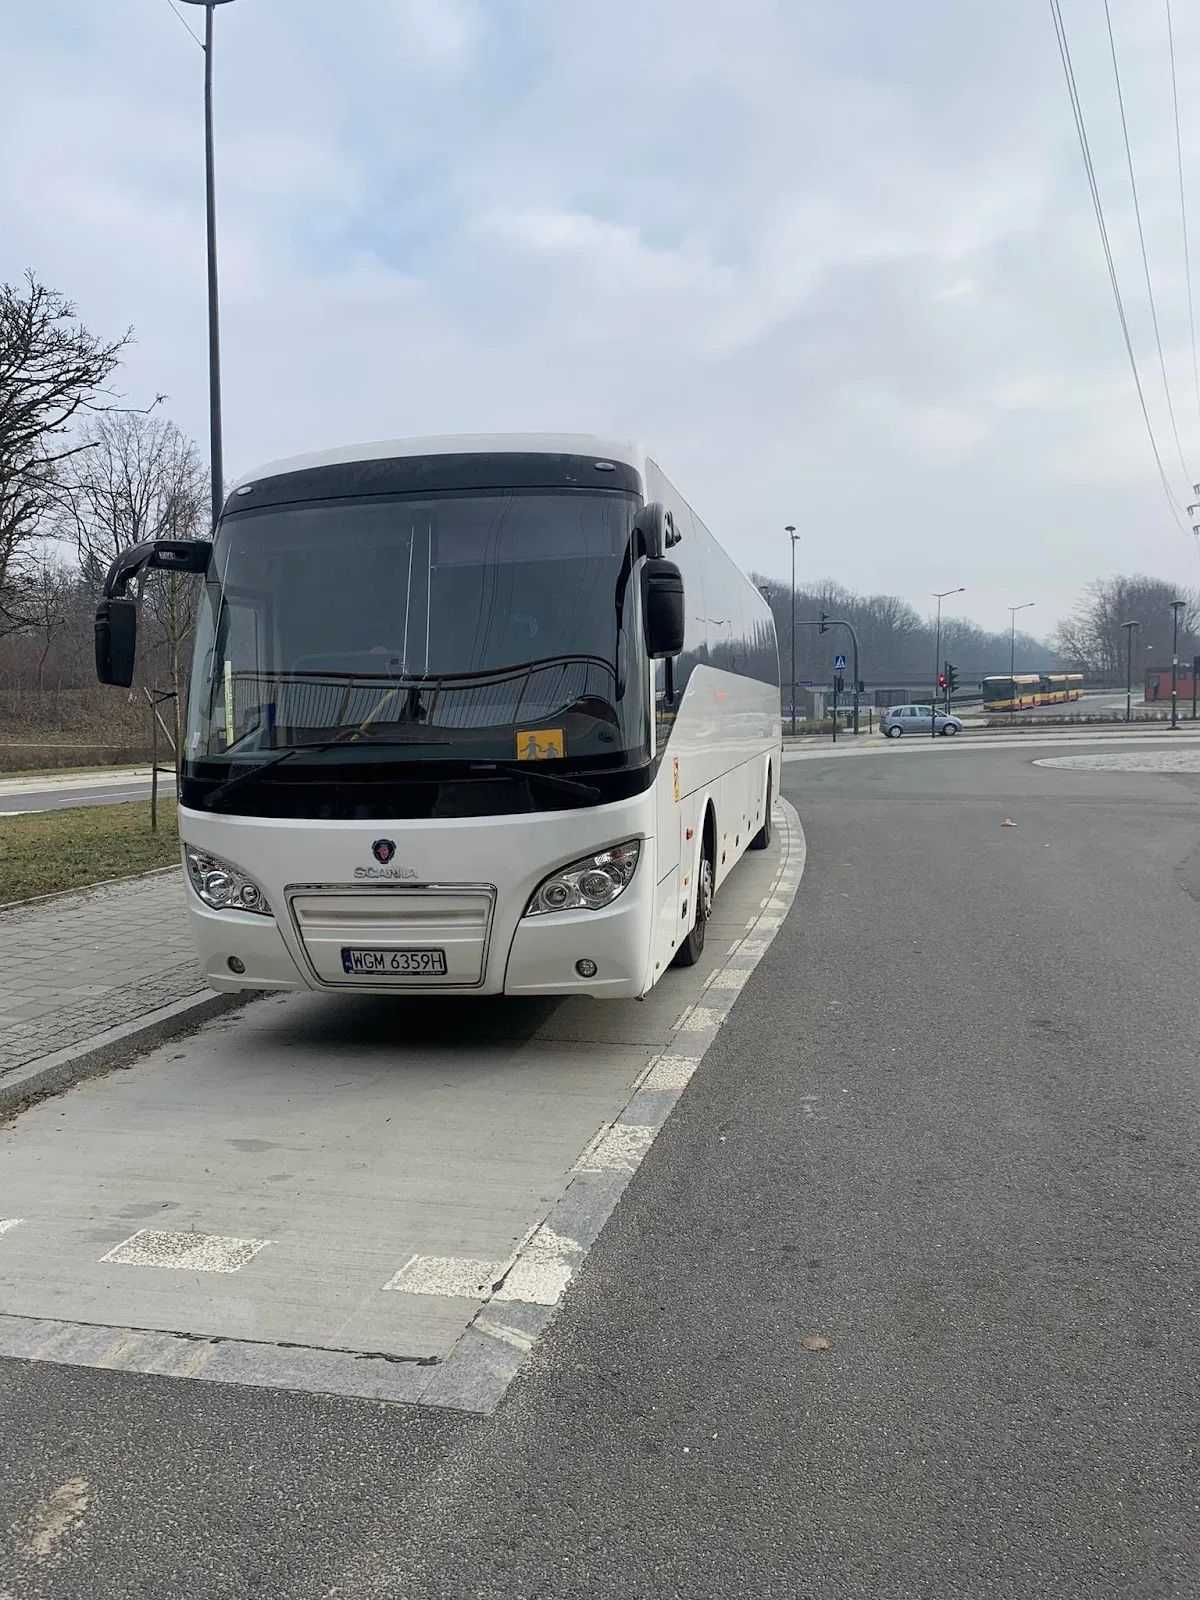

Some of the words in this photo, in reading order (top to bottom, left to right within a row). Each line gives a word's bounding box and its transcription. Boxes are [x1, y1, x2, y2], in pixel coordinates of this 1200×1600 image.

[354, 867, 419, 879] SCANIA
[353, 953, 385, 969] WGM
[391, 953, 443, 969] 6359H
